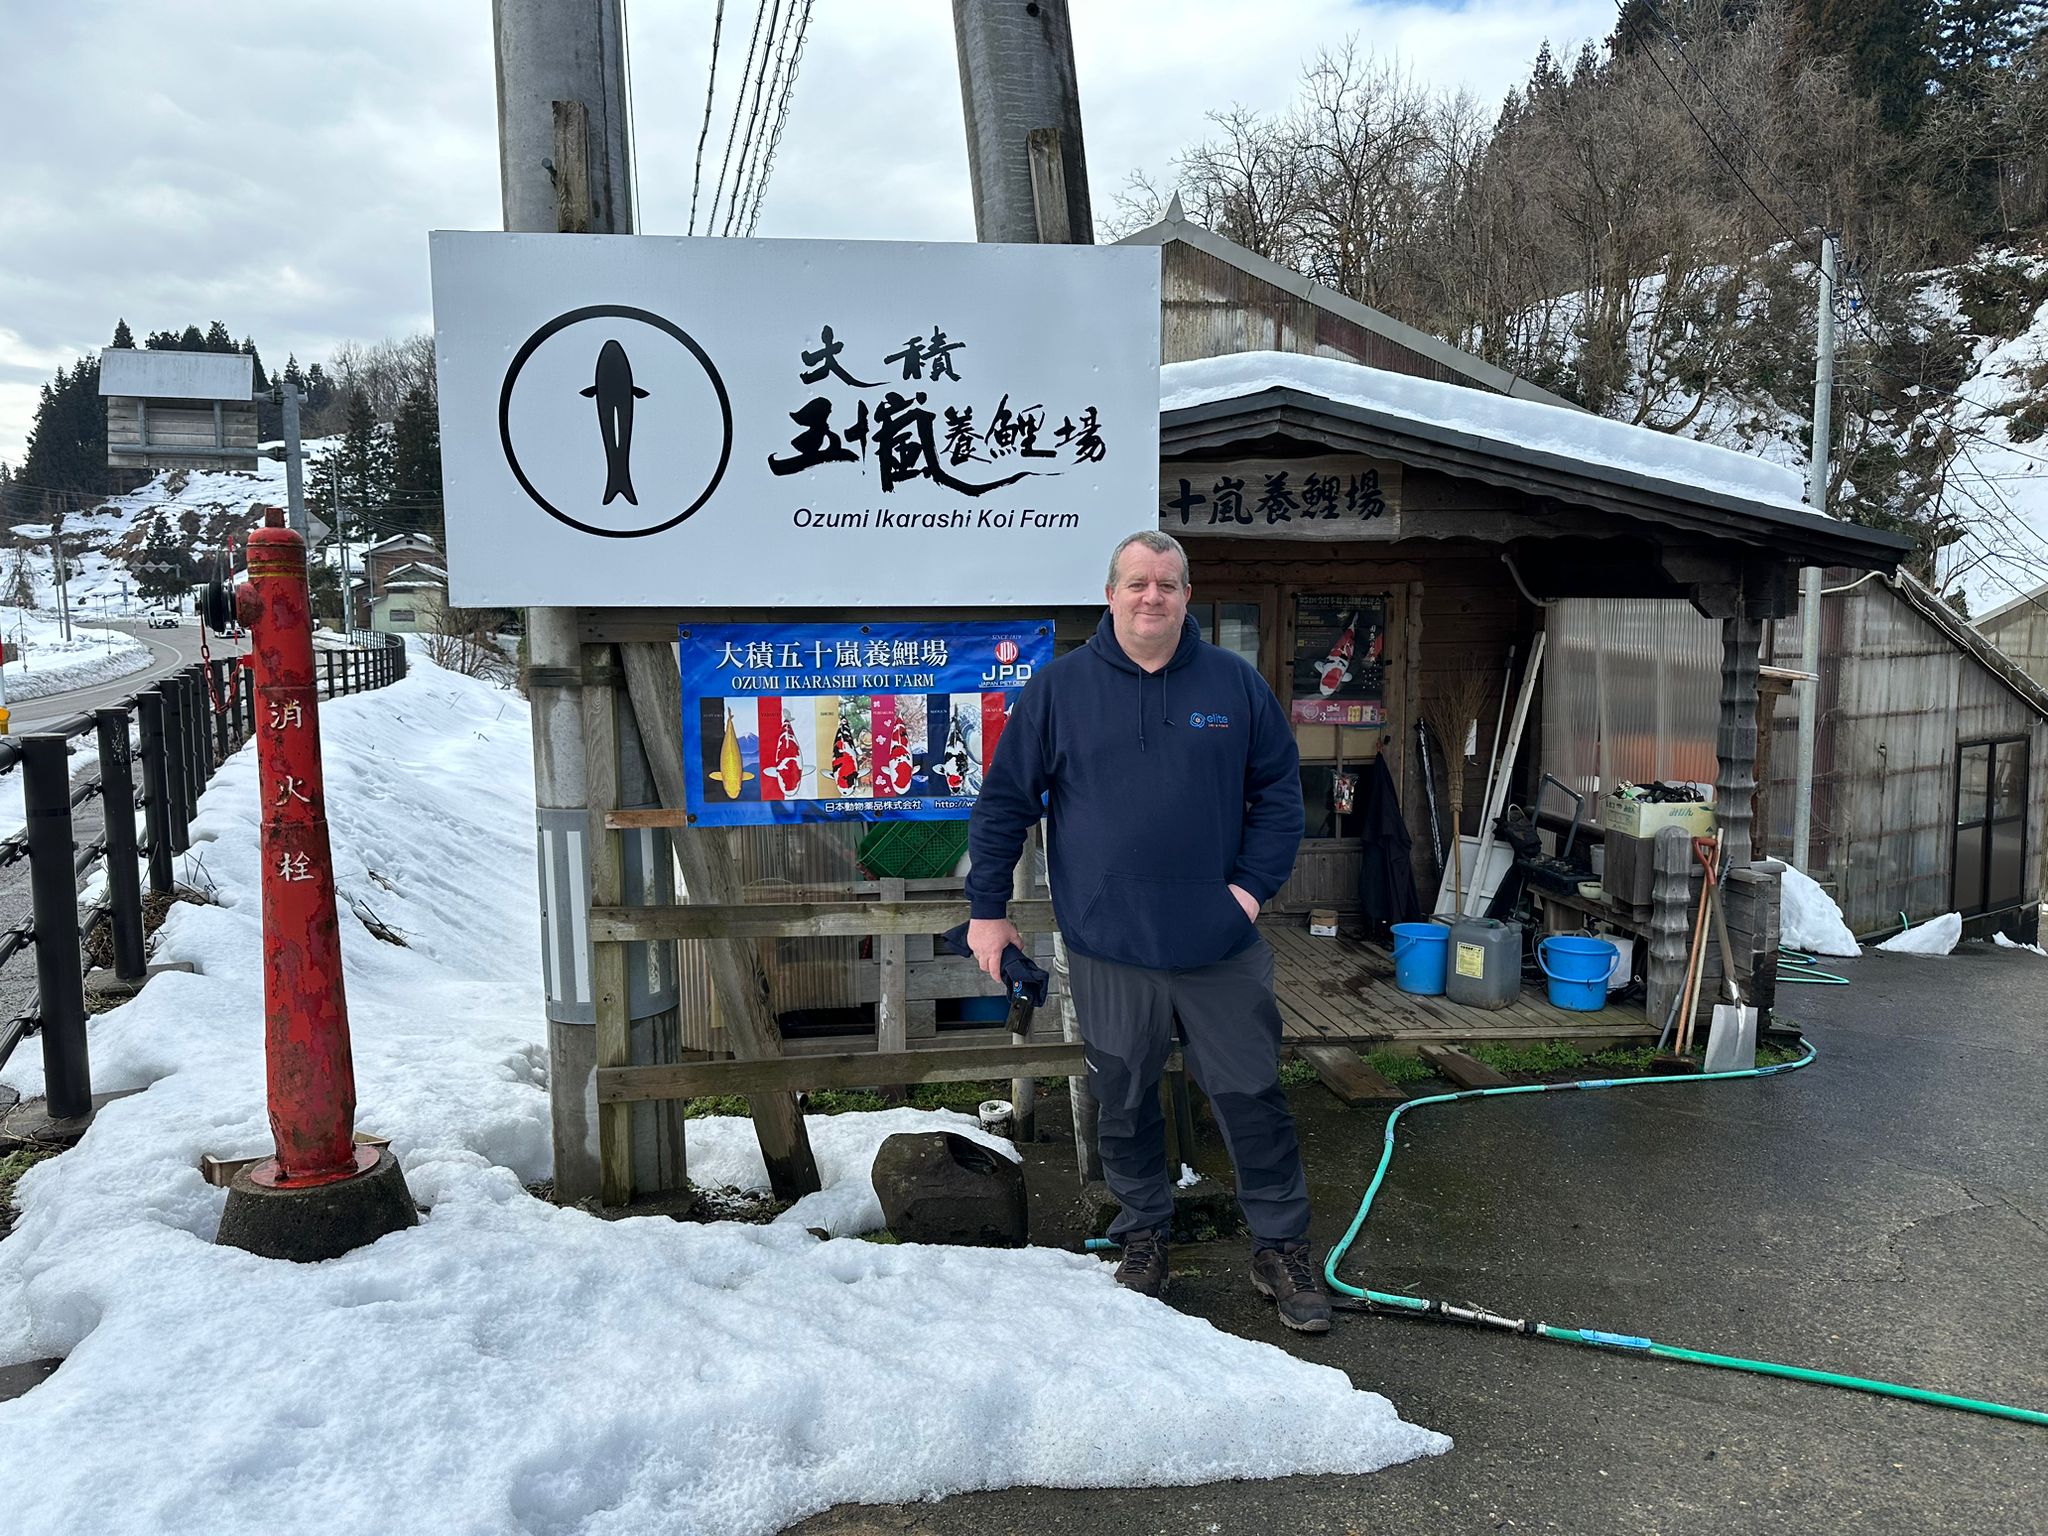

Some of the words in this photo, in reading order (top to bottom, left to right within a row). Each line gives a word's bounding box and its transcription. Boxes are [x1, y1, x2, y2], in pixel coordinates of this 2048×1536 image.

[799, 325, 966, 388] 大積
[767, 391, 1107, 497] 五十嵐養鯉場
[1159, 468, 1386, 525] 十嵐養鯉場
[794, 508, 869, 528] Ozumi
[875, 508, 972, 528] Ikarashi
[977, 508, 1015, 528] Koi
[1019, 508, 1080, 528] Farm
[715, 639, 949, 671] 大積五十嵐養鯉場
[731, 676, 779, 690] OZUMI
[785, 675, 857, 689] IKARASHI
[862, 674, 890, 688] KOI
[895, 673, 935, 688] FARM
[981, 664, 1032, 681] JPD
[1207, 713, 1228, 723] elite
[270, 700, 315, 882] 消火栓
[825, 799, 922, 813] 日本動物薬品株式会社
